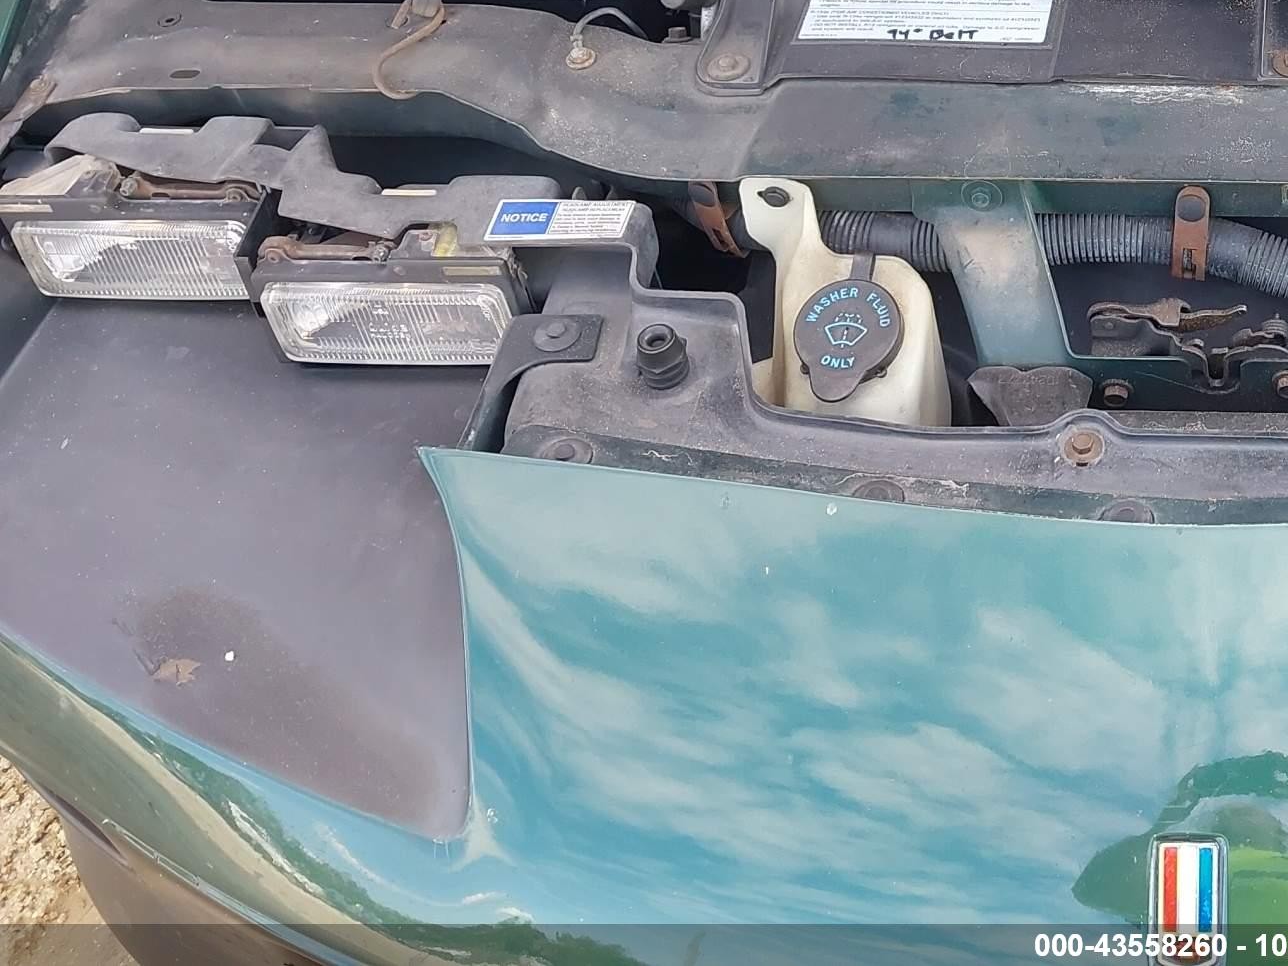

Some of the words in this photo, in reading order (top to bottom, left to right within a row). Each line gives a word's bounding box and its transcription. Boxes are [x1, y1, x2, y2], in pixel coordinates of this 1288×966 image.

[500, 212, 549, 223] NOTICE
[806, 287, 859, 322] WASHER
[866, 292, 892, 328] FLUID
[820, 355, 856, 369] ONLY
